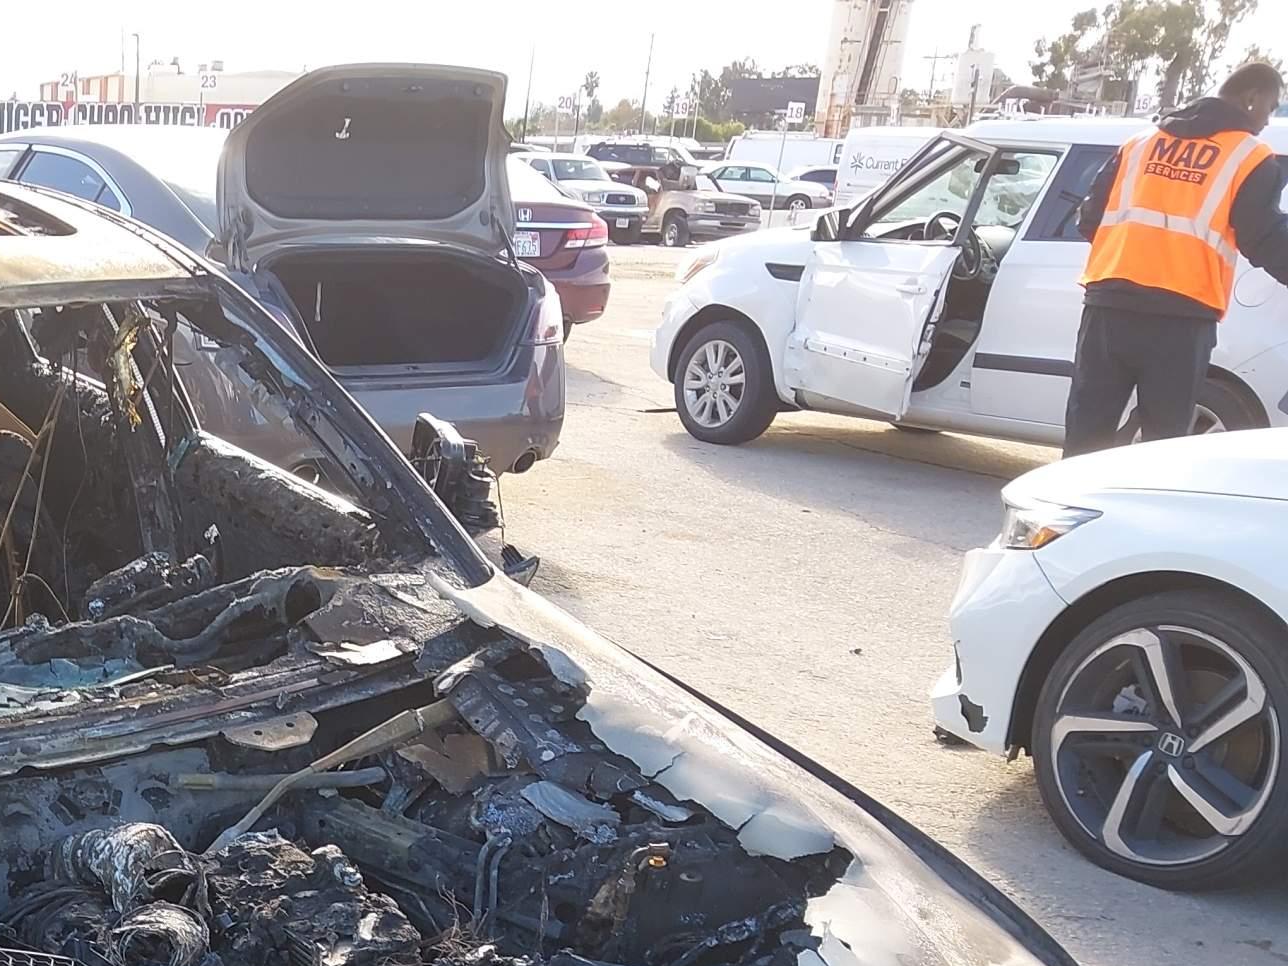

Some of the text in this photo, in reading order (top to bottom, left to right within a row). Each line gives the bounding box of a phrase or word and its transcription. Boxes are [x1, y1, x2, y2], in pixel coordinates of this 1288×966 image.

[201, 75, 217, 88] 23
[558, 96, 572, 109] 20
[674, 102, 688, 115] 19
[787, 106, 803, 118] 18
[1148, 137, 1221, 170] MAD
[1146, 163, 1203, 183] SERVICES
